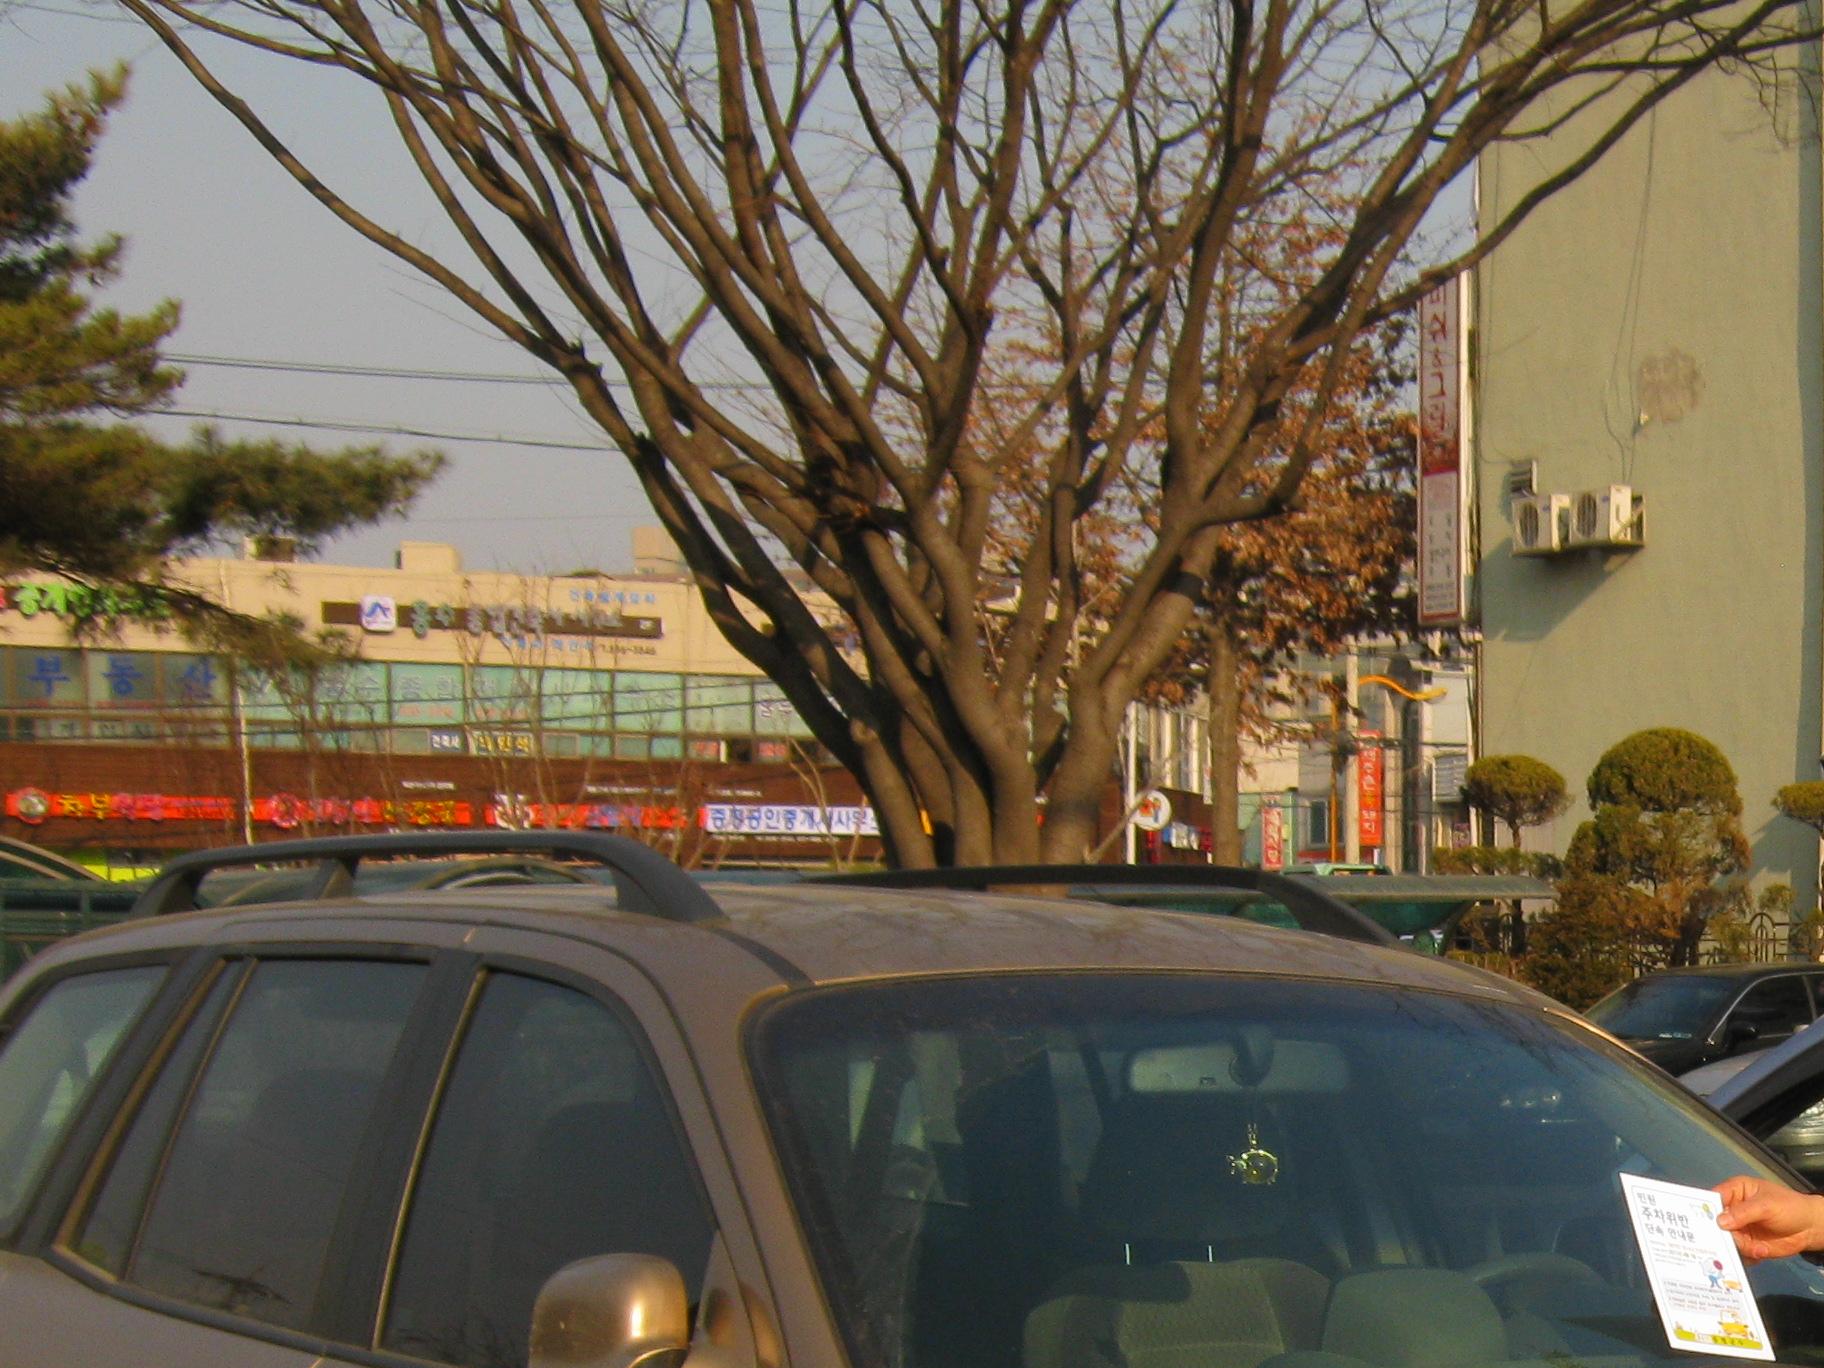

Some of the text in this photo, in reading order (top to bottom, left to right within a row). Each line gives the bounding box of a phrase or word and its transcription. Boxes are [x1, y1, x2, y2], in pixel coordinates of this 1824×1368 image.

[27, 655, 217, 700] 부동산
[1636, 1192, 1657, 1206] 민원
[1641, 1206, 1689, 1229] 주차위반
[1645, 1223, 1696, 1244] 단속 안내문
